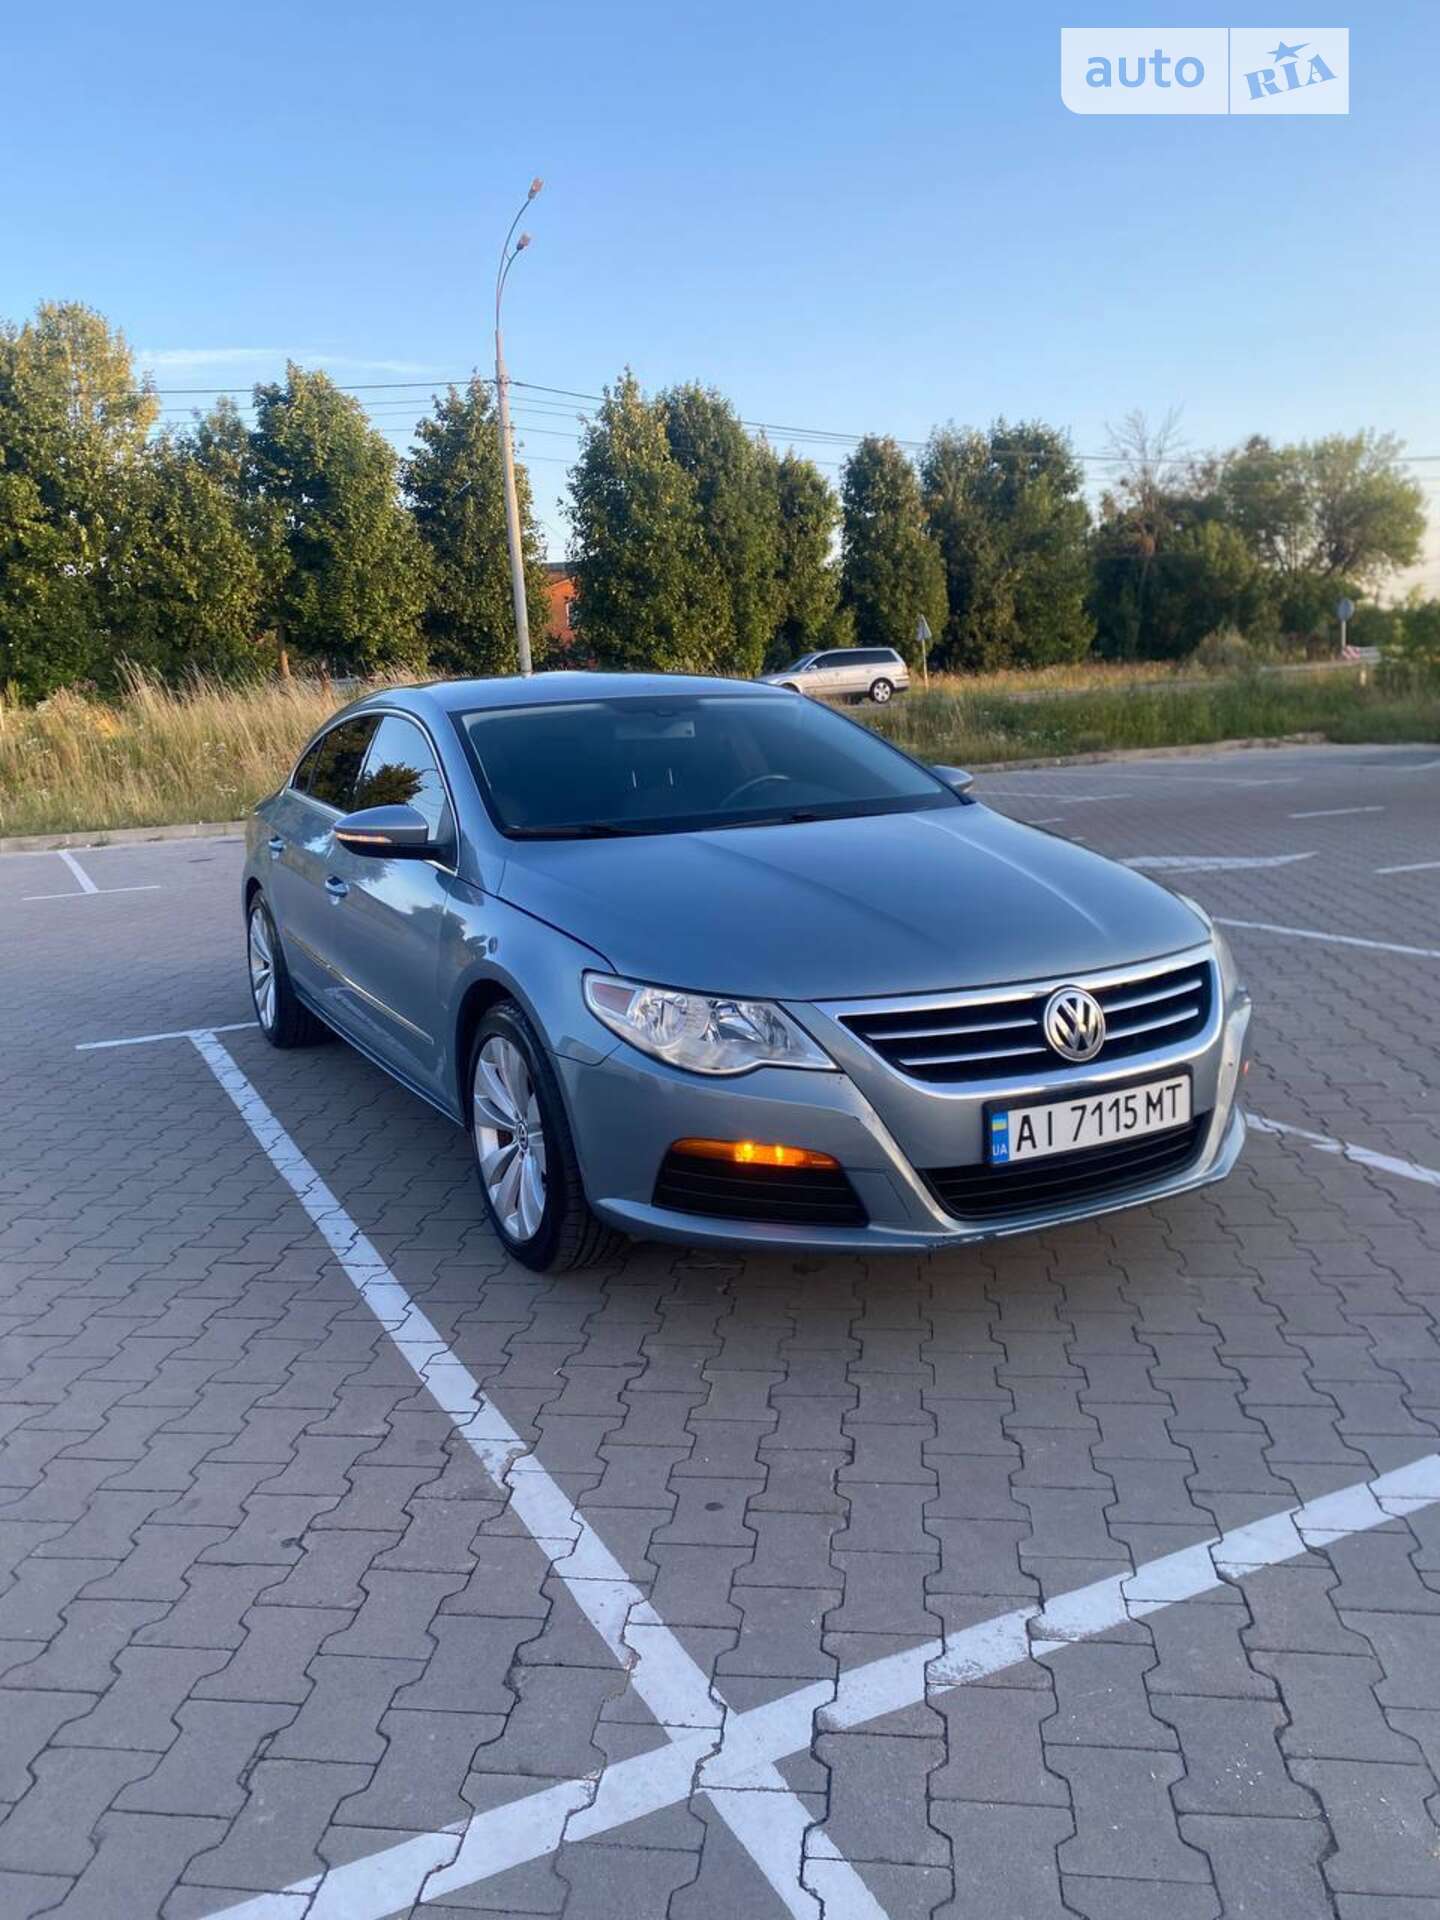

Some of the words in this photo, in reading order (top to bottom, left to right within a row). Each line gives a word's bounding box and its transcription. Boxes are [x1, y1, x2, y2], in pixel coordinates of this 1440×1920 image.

[1016, 1110, 1053, 1152] AI
[1071, 1094, 1137, 1142] 7115
[1146, 1083, 1183, 1125] MT
[992, 1143, 1009, 1156] UA
